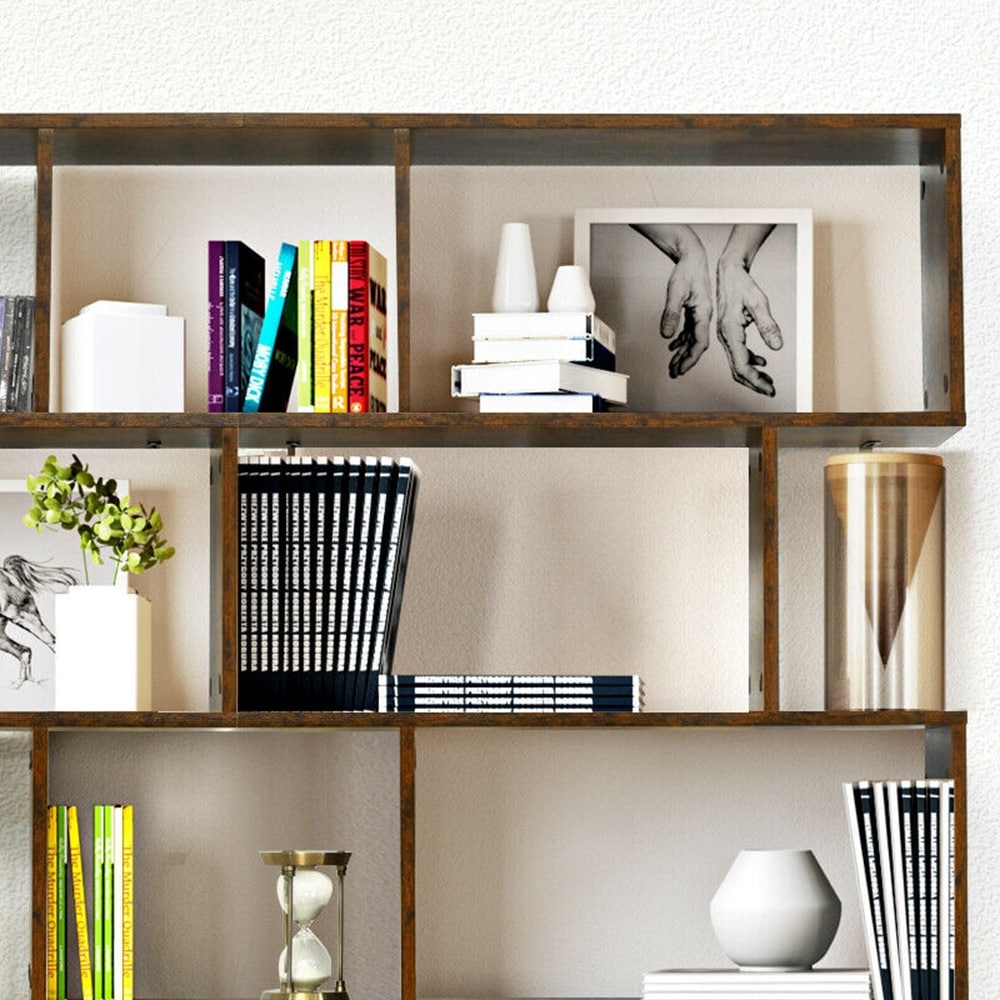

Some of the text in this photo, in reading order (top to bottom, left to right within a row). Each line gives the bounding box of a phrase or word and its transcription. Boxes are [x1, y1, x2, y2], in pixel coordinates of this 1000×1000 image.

[349, 288, 365, 327] WAR
[245, 343, 273, 404] MOBY DICK
[349, 344, 366, 398] PEACE
[48, 872, 57, 916] Murder
[48, 920, 57, 979] Quadrille
